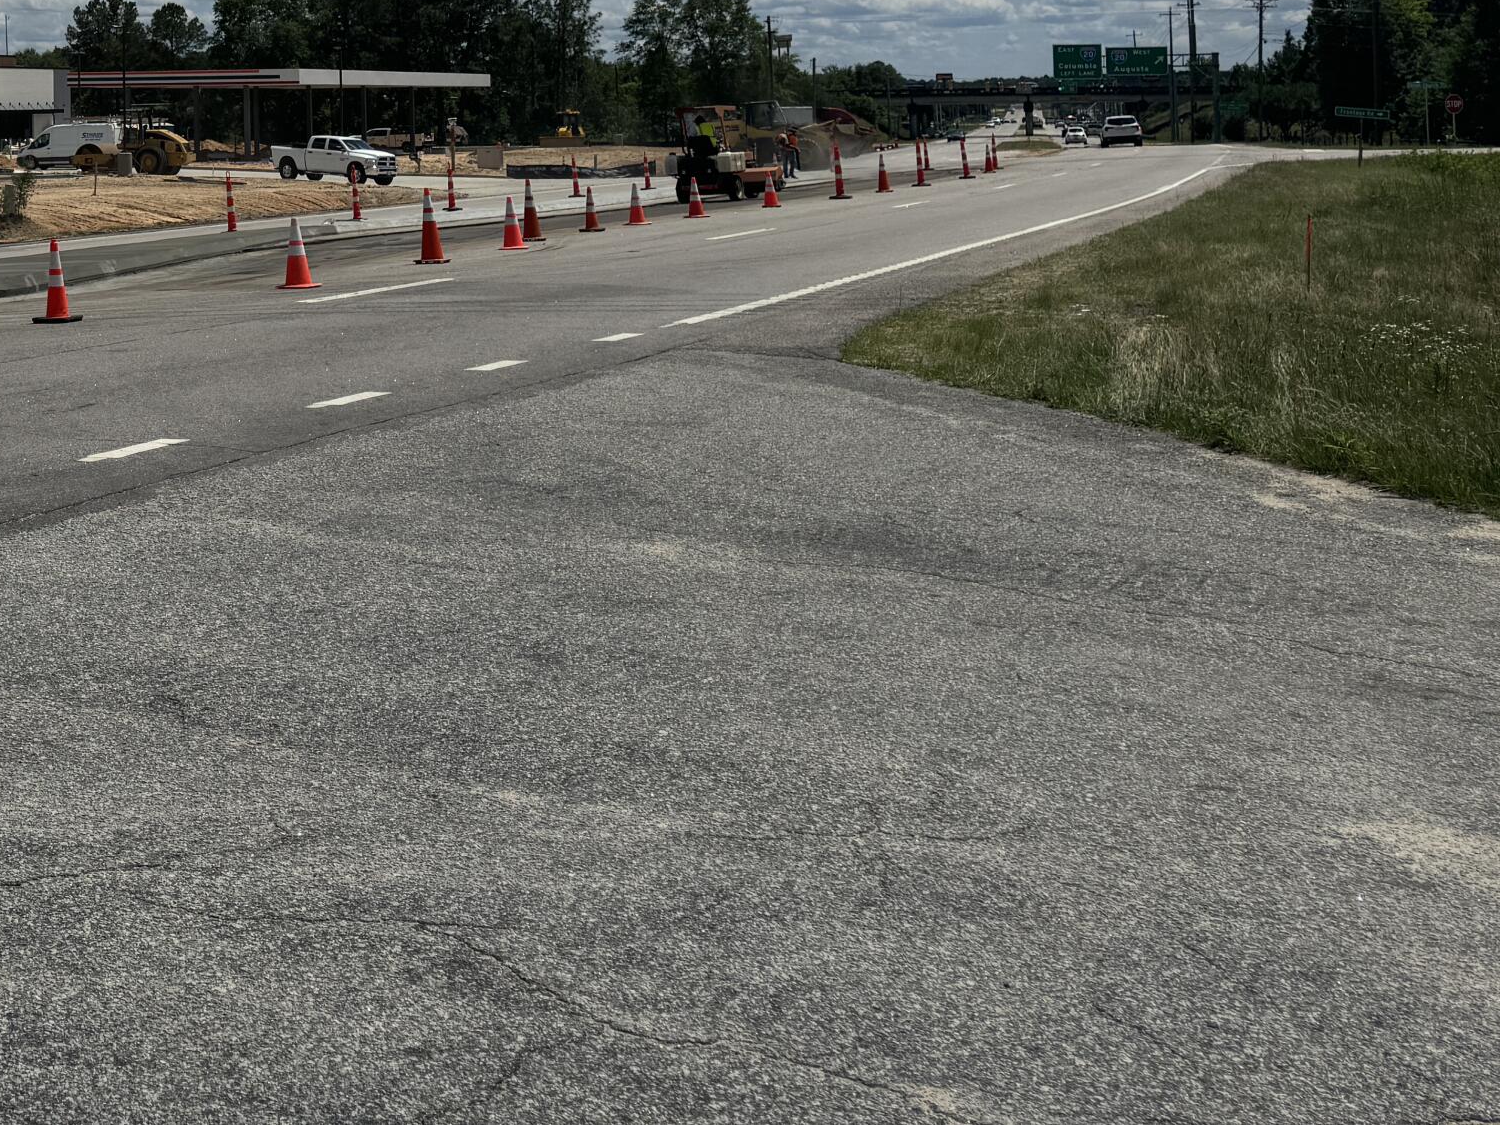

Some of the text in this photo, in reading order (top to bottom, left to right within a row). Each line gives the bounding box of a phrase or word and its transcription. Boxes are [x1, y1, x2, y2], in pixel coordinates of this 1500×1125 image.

[1083, 50, 1094, 58] 20
[1113, 66, 1149, 74] Augusta
[1446, 100, 1462, 108] STOP
